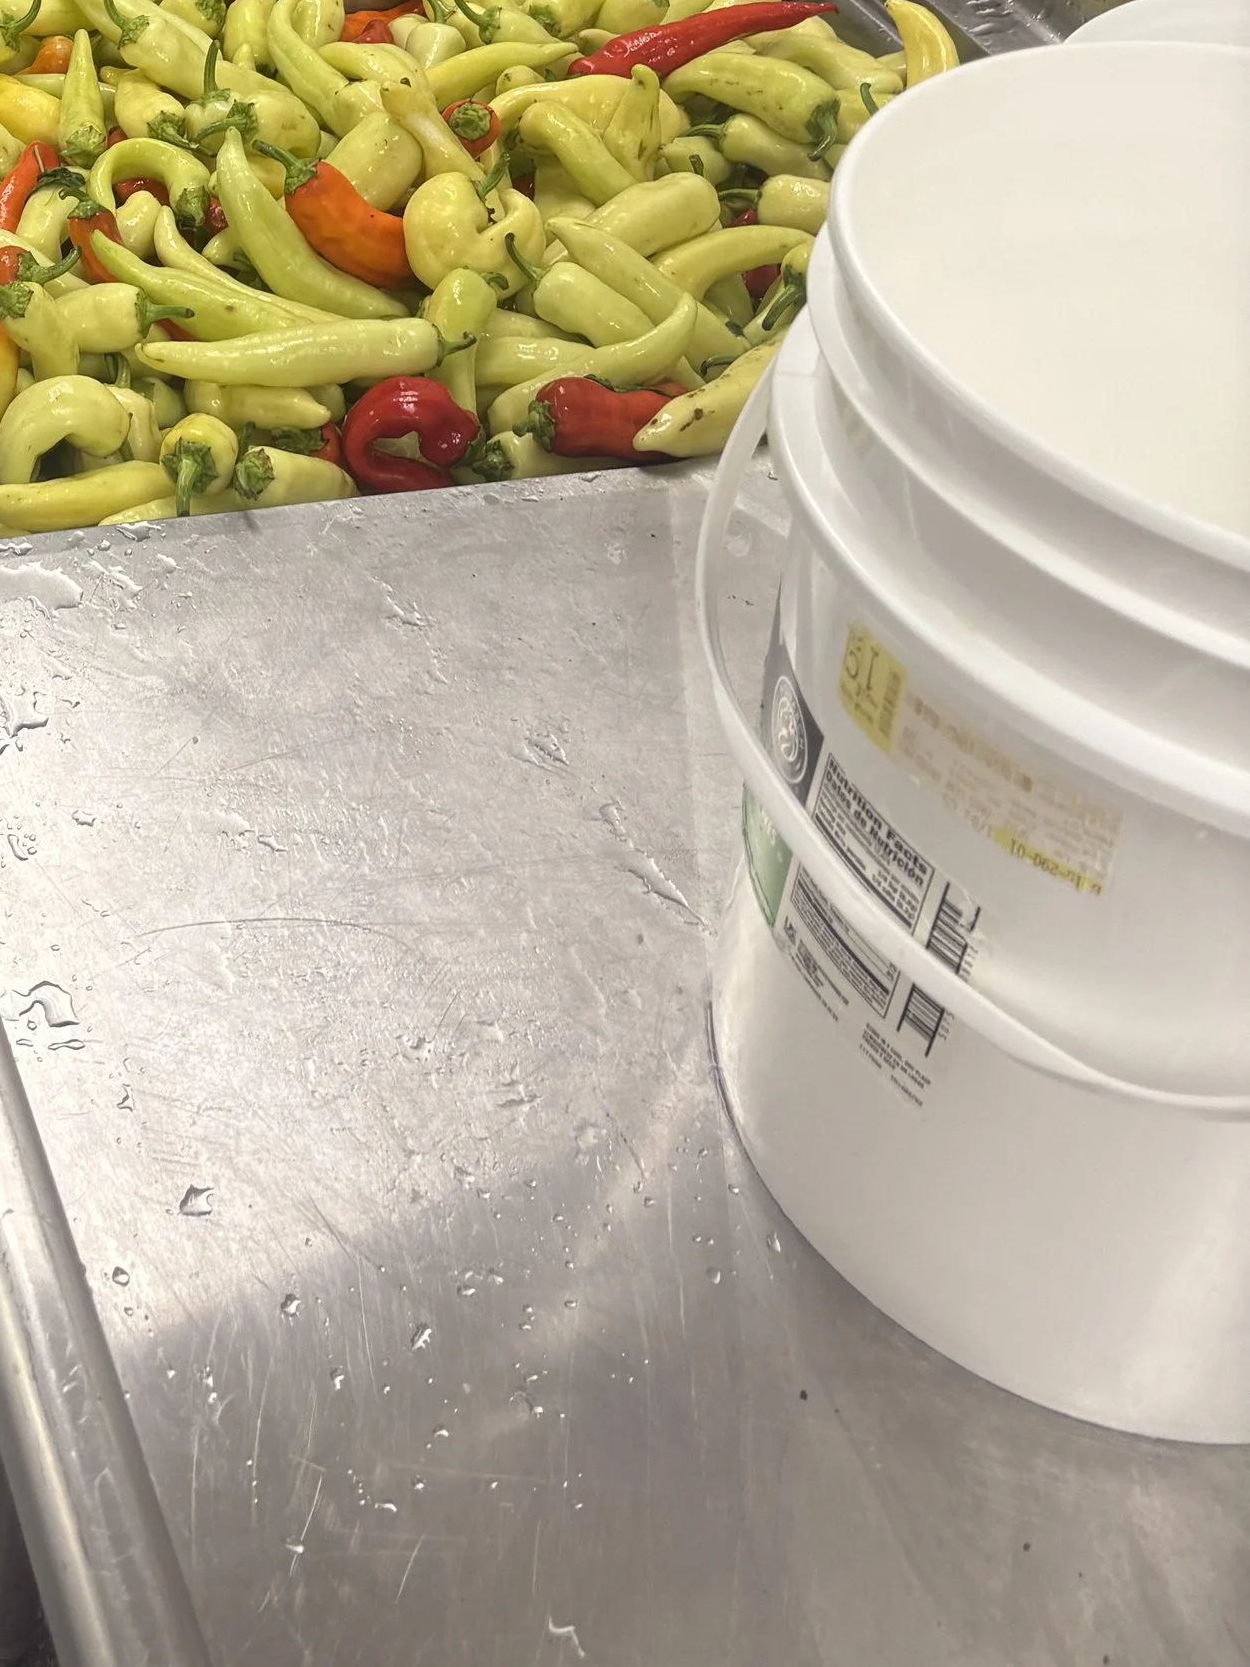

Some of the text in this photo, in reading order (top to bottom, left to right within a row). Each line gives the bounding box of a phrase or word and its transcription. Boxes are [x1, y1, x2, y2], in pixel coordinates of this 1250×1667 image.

[824, 769, 926, 886] Datos de Nutrición
[828, 758, 883, 831] Nutrition
[886, 830, 928, 876] Facts
